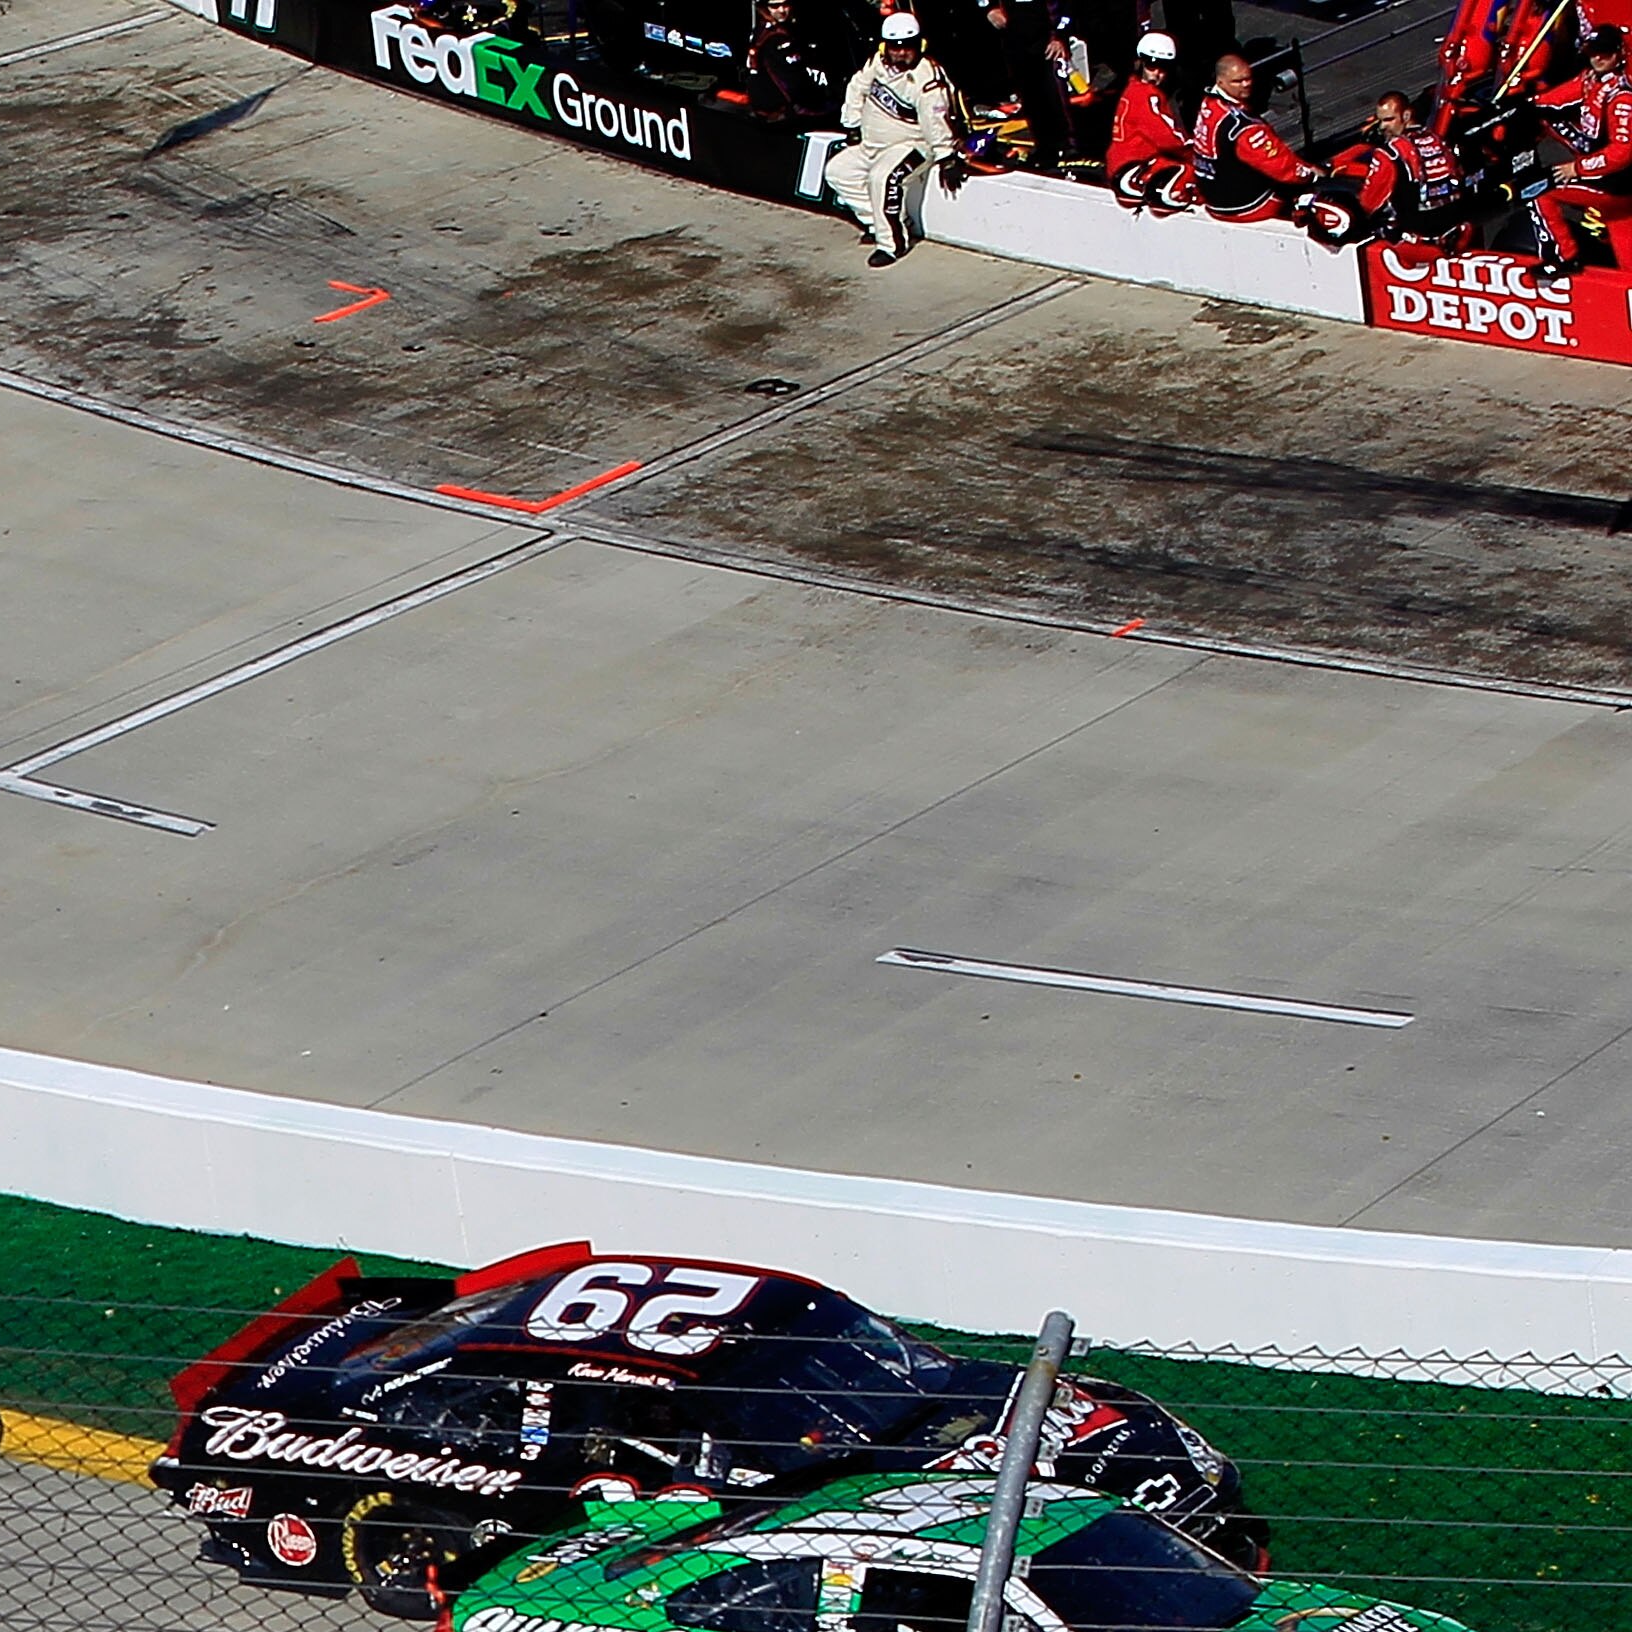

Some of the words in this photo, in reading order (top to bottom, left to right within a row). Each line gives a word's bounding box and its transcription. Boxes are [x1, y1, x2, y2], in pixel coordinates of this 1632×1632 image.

[552, 72, 692, 161] Ground
[201, 1406, 522, 1497] Budweiser
[191, 1486, 250, 1516] Bud
